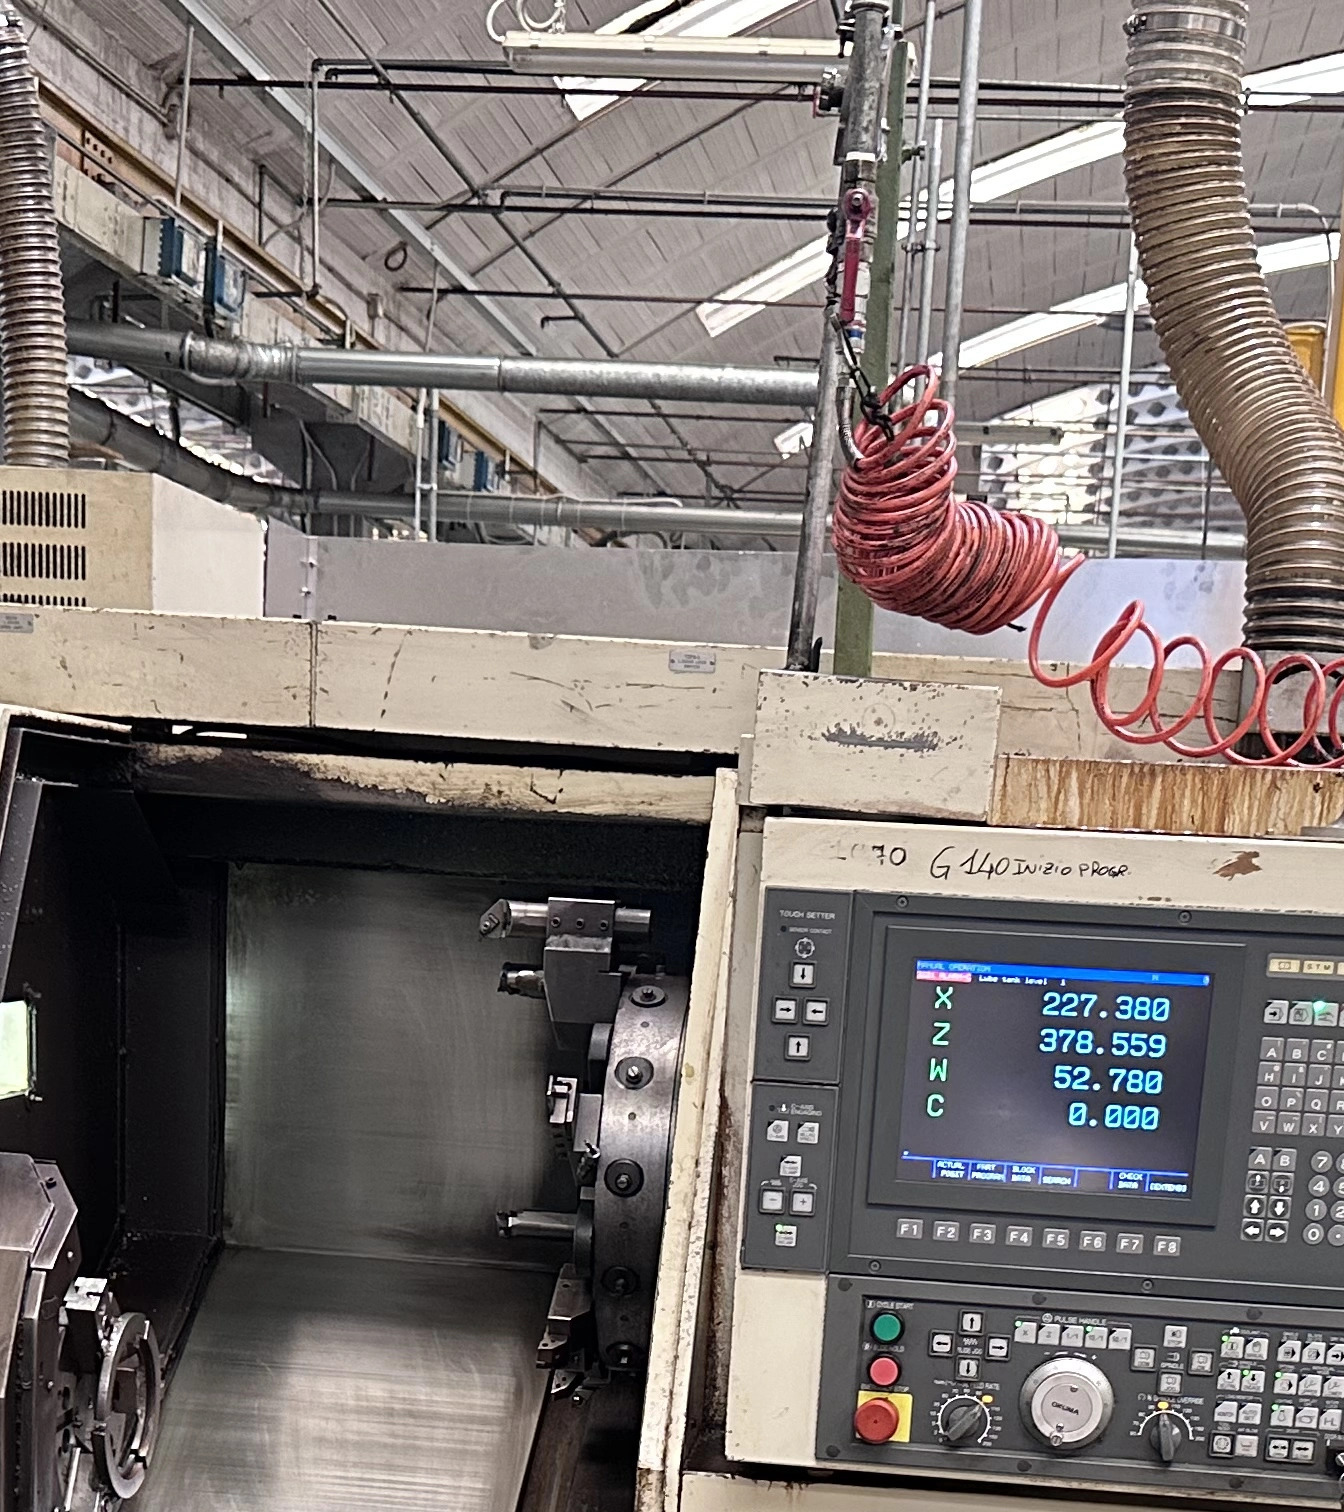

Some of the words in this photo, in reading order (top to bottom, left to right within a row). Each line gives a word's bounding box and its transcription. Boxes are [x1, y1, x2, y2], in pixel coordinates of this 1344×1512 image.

[930, 846, 954, 880] G
[959, 849, 1010, 880] 140
[779, 910, 804, 918] TOUCH
[806, 911, 836, 919] SETTER
[934, 985, 954, 1010] X
[1042, 991, 1171, 1022] 227.380
[932, 1022, 951, 1047] Z
[1039, 1028, 1167, 1058] 378.559
[1266, 1047, 1277, 1058] A
[1292, 1048, 1302, 1059] B
[1317, 1050, 1327, 1061] C
[929, 1057, 948, 1082] W
[1053, 1065, 1163, 1094] 52.780
[1264, 1072, 1274, 1082] H
[1291, 1073, 1296, 1084] I
[1315, 1075, 1323, 1085] J
[1287, 1097, 1296, 1108] P
[1310, 1099, 1321, 1111] Q
[926, 1093, 945, 1117] C
[1068, 1101, 1160, 1130] 0.000
[1259, 1121, 1269, 1131] V
[1283, 1122, 1295, 1133] W
[1309, 1123, 1318, 1134] X
[1334, 1125, 1343, 1135] Y
[1254, 1153, 1266, 1165] A
[1279, 1155, 1290, 1166] B
[1317, 1157, 1328, 1168] 7
[1313, 1180, 1325, 1192] 4
[1313, 1205, 1320, 1216] 1
[900, 1224, 918, 1236] F1
[937, 1226, 956, 1238] F2
[973, 1228, 992, 1241] F3
[1009, 1231, 1028, 1243] F4
[1046, 1233, 1065, 1246] F5
[1083, 1236, 1102, 1248] F6
[1120, 1238, 1139, 1251] F7
[1157, 1241, 1177, 1254] F8
[1051, 1402, 1080, 1416] OKUMA
